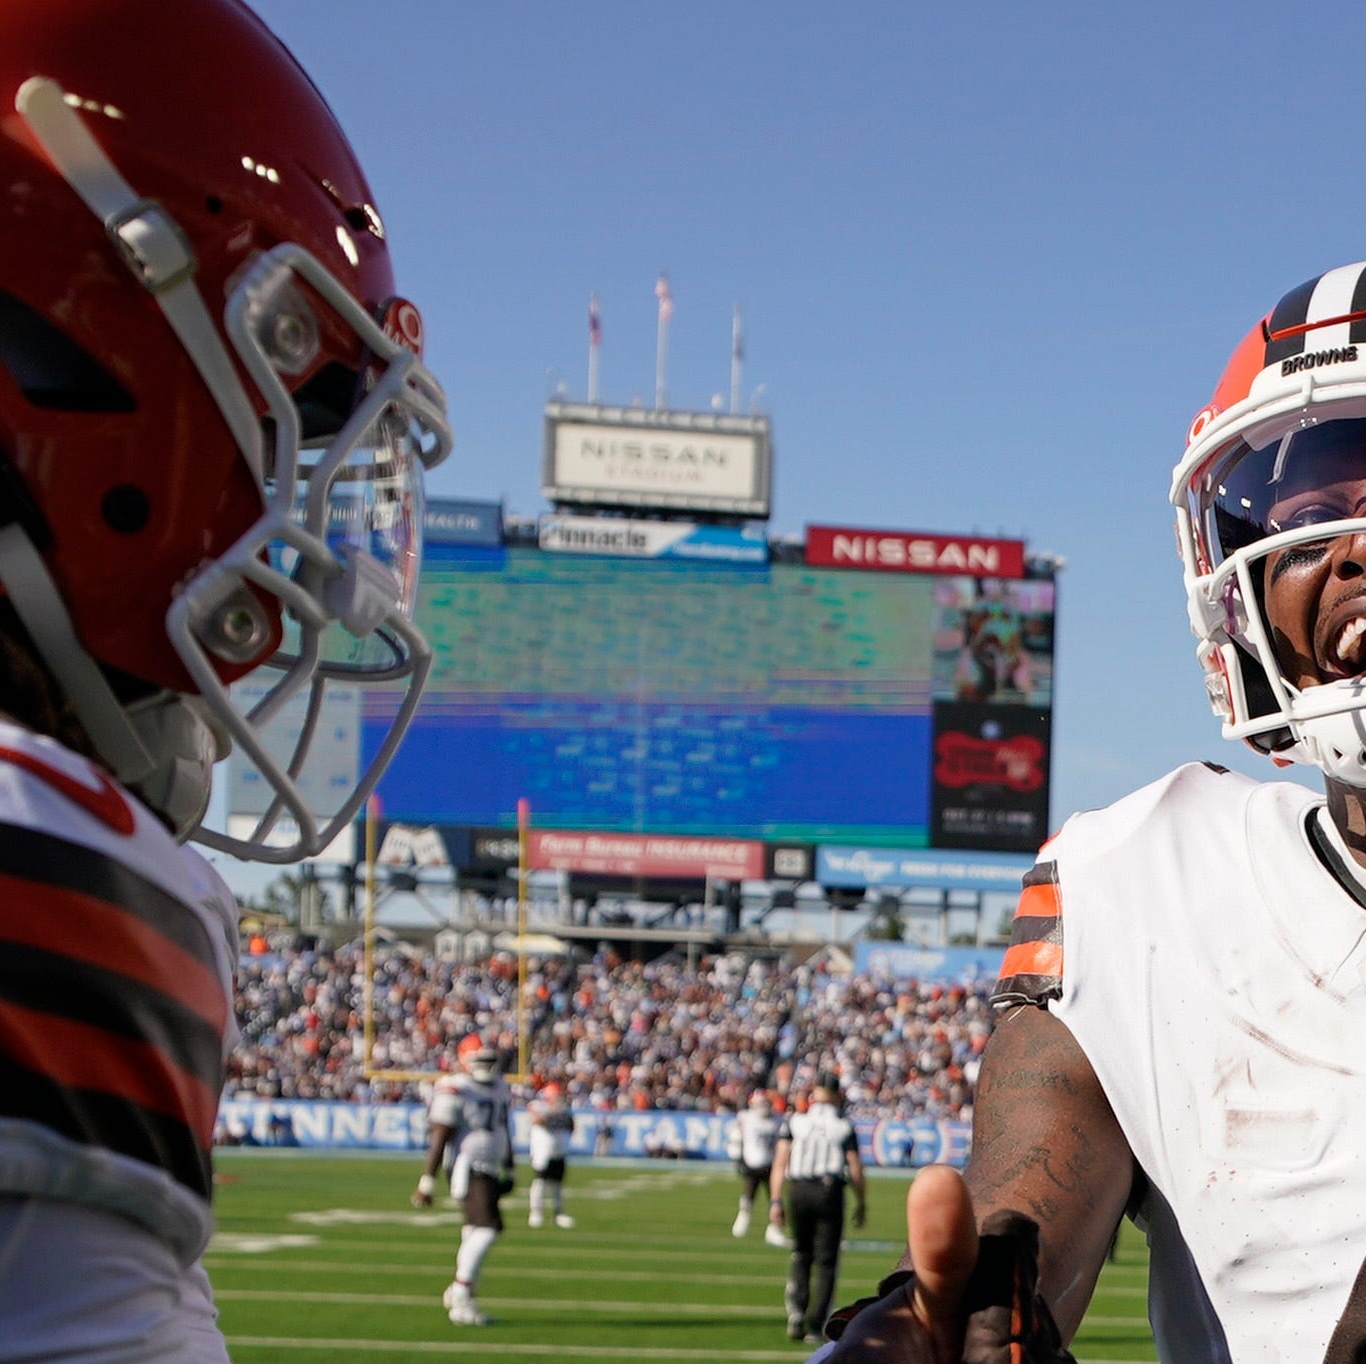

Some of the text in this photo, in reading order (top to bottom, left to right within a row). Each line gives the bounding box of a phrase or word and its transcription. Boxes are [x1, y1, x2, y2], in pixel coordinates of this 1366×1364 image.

[1281, 346, 1359, 378] BROWNS
[580, 438, 728, 468] NISSAN
[833, 534, 999, 572] NISSAN
